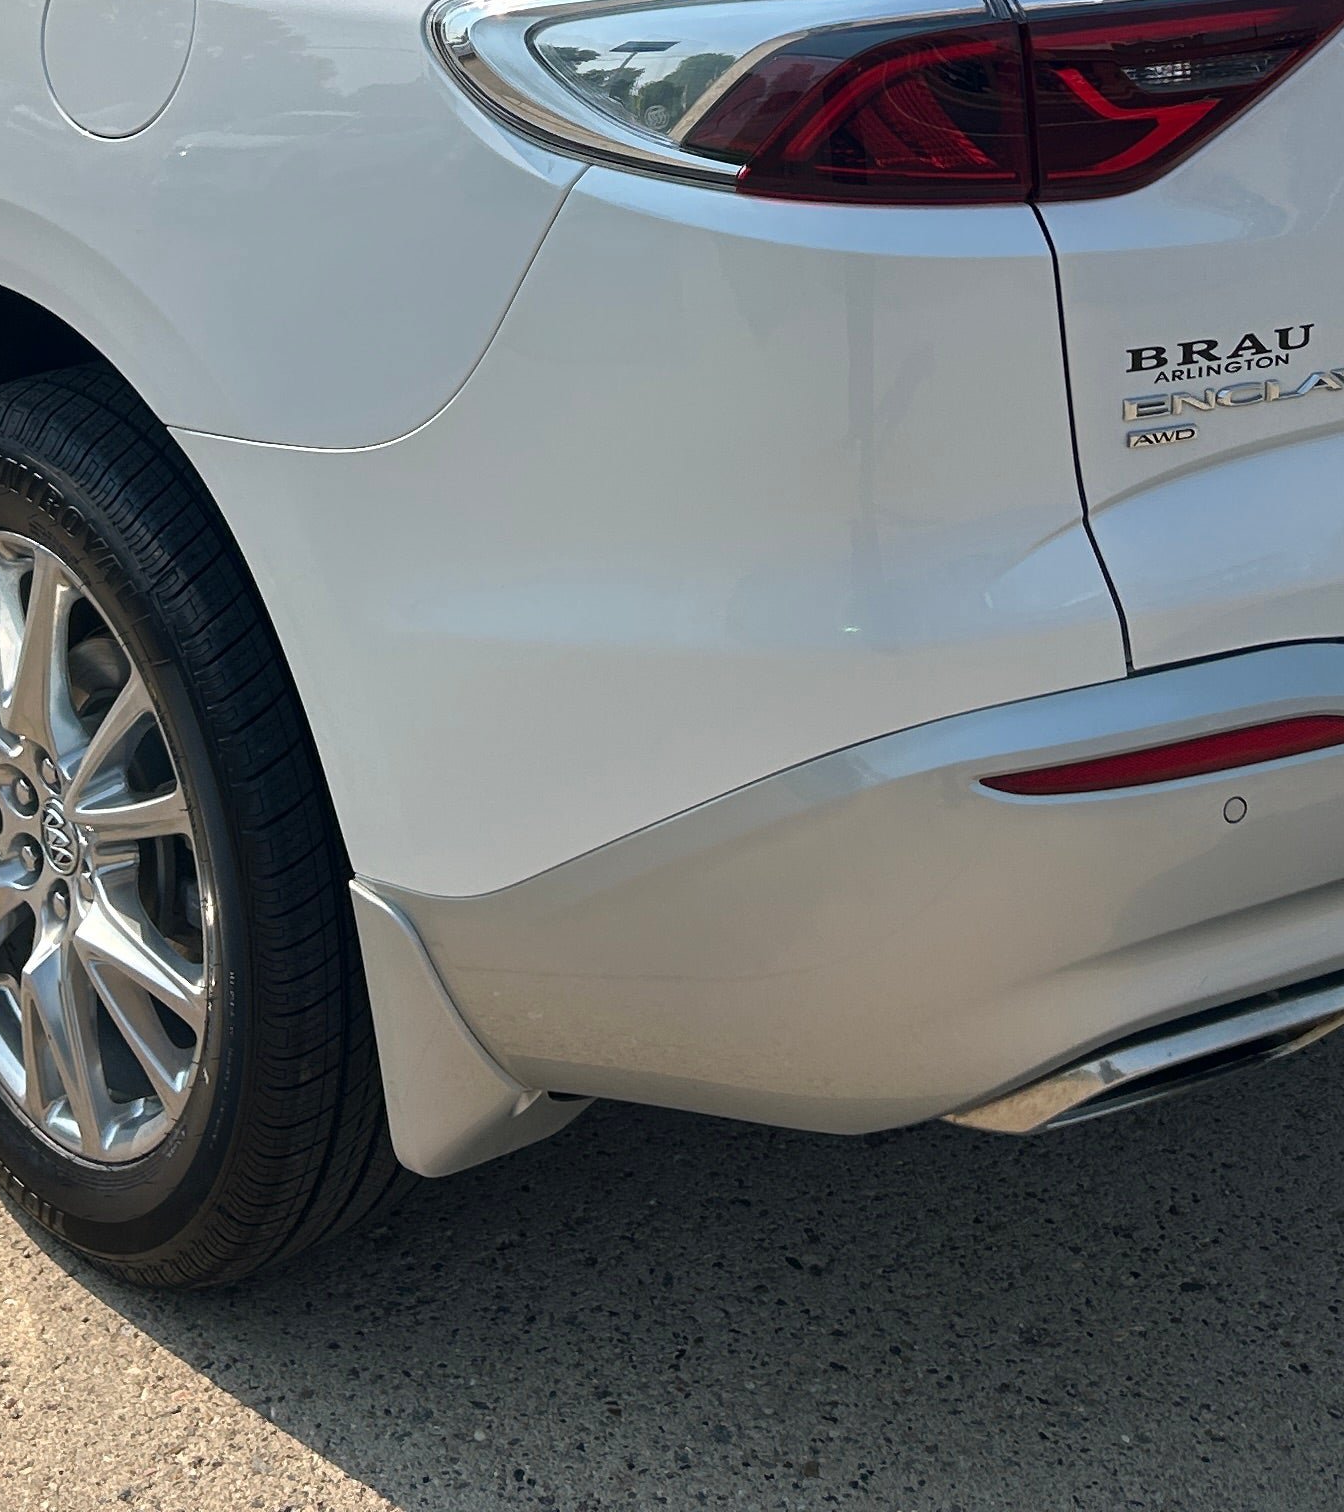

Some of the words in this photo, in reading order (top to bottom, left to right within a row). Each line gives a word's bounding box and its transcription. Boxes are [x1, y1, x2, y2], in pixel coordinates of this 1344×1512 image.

[1126, 324, 1315, 374] BRAU
[1154, 352, 1291, 385] ARLINGTON
[1131, 426, 1197, 448] AWD
